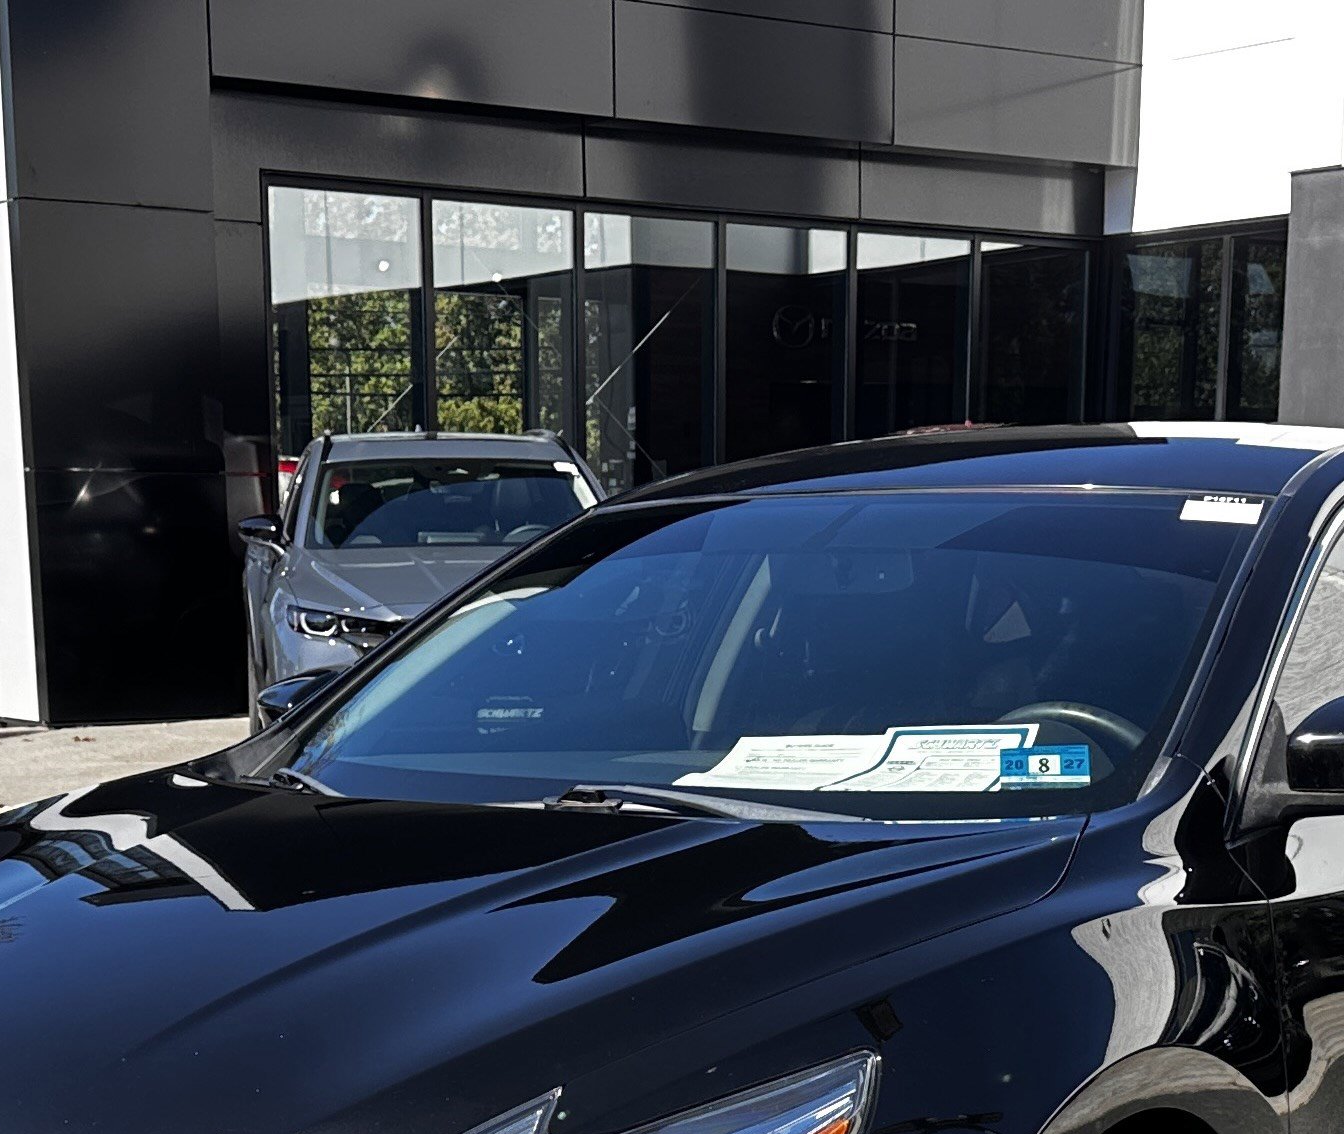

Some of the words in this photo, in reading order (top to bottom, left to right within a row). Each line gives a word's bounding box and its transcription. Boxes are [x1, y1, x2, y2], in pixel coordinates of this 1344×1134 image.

[1005, 759, 1024, 770] 20
[1038, 758, 1050, 773] 8
[1064, 758, 1086, 769] 27
